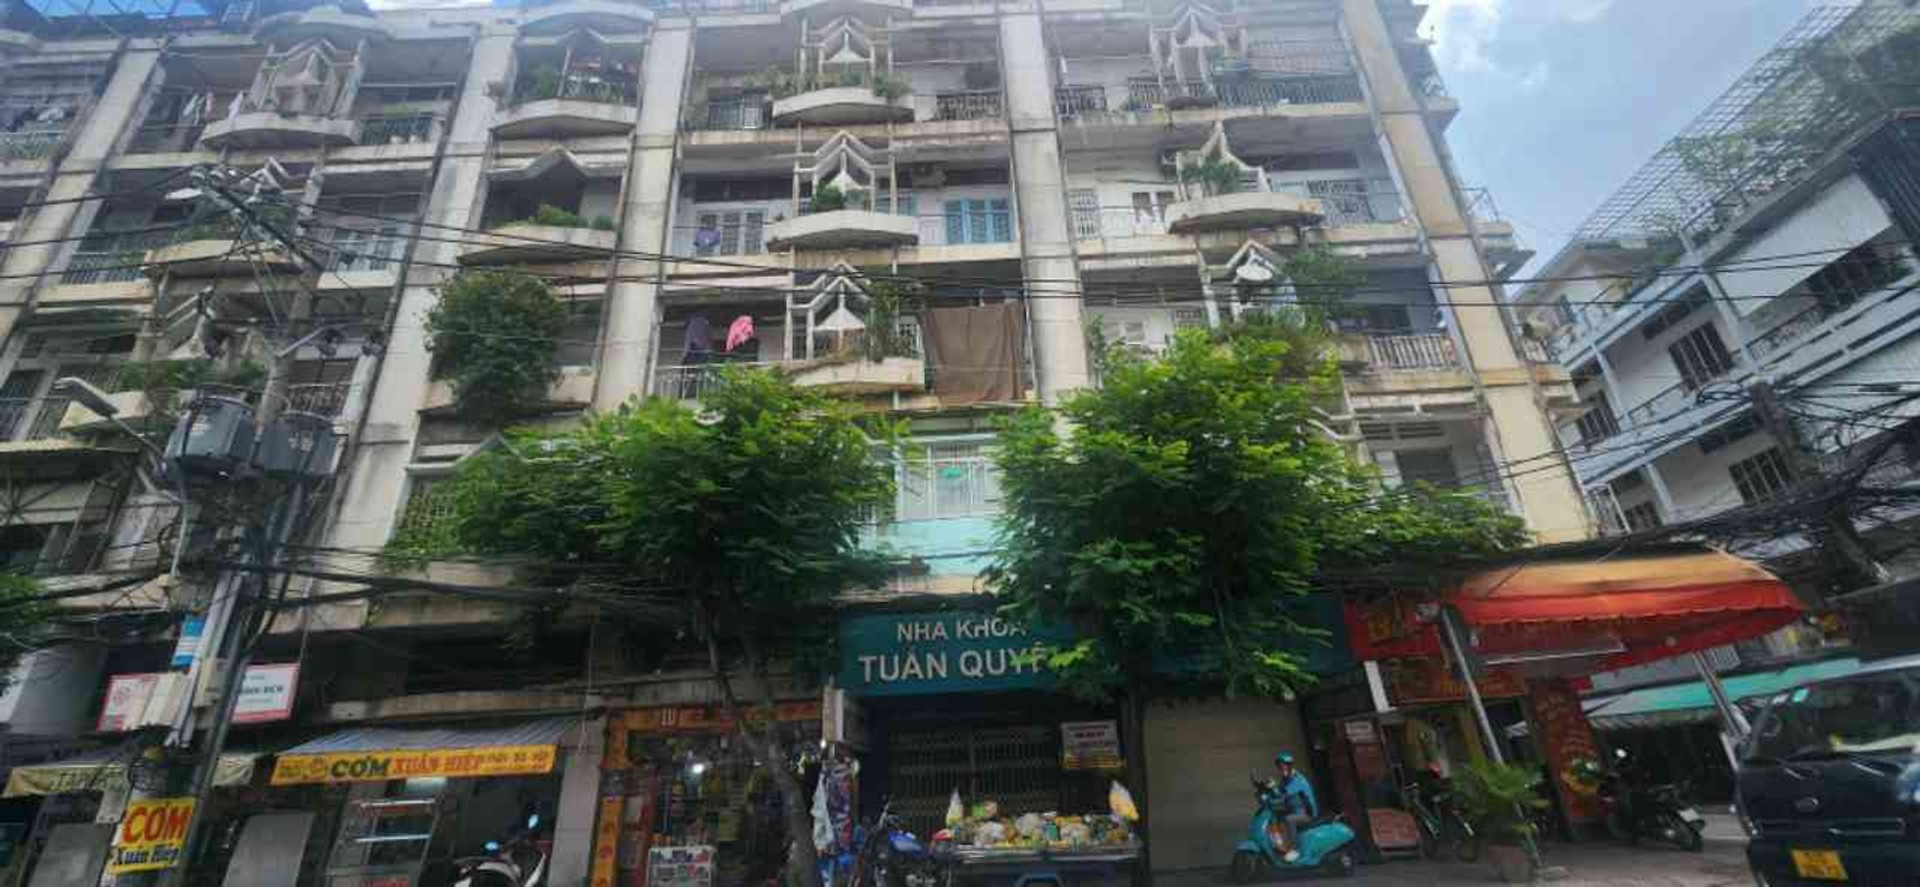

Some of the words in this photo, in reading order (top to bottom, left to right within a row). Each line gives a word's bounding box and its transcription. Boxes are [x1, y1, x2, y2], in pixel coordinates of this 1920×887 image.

[896, 622, 949, 642] NHA
[331, 754, 388, 777] CƠM
[123, 801, 193, 843] CƠM
